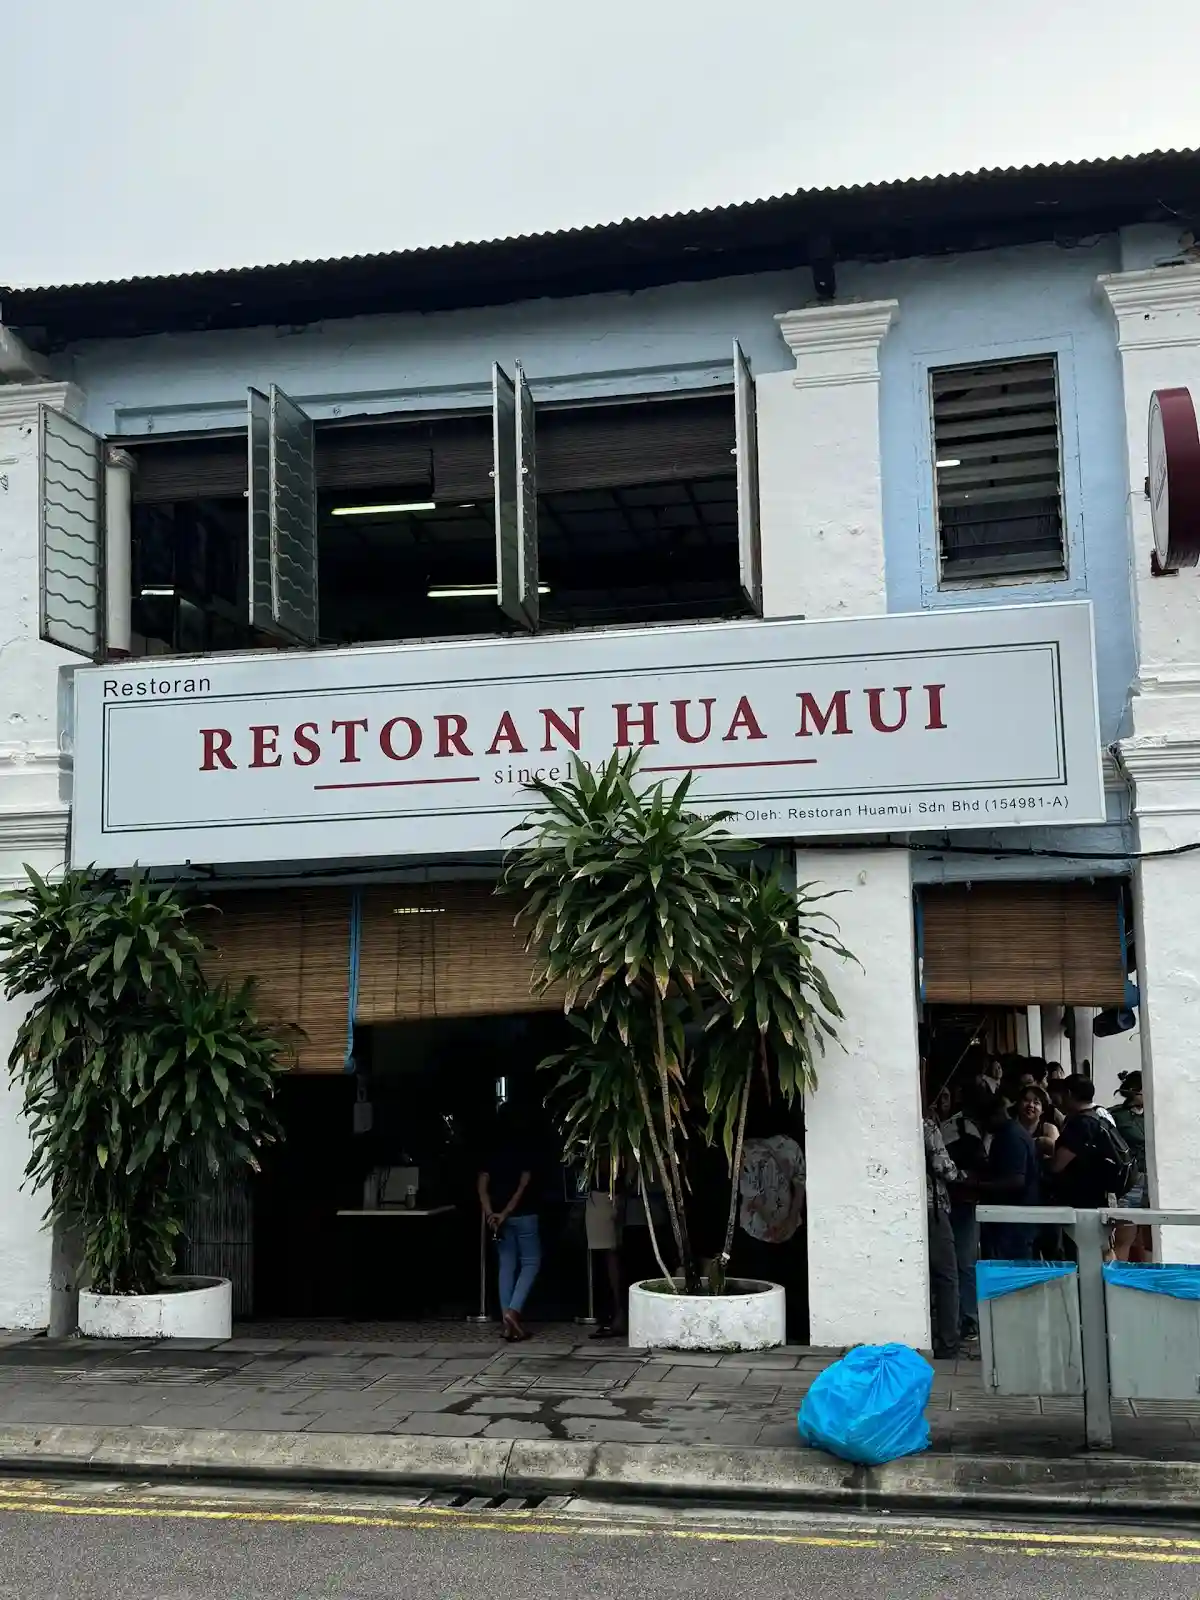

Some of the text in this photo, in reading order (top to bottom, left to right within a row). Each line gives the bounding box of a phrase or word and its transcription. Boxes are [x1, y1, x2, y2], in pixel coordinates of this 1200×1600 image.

[103, 678, 211, 698] Restoran
[199, 684, 948, 771] RESTORAN HUA MUI
[745, 808, 782, 822] Oleh:
[788, 807, 852, 819] Restoran
[858, 804, 912, 816] Huamui
[918, 801, 946, 813] Sdn
[952, 800, 980, 812] Bhd
[984, 795, 1070, 813] (154981-A)
